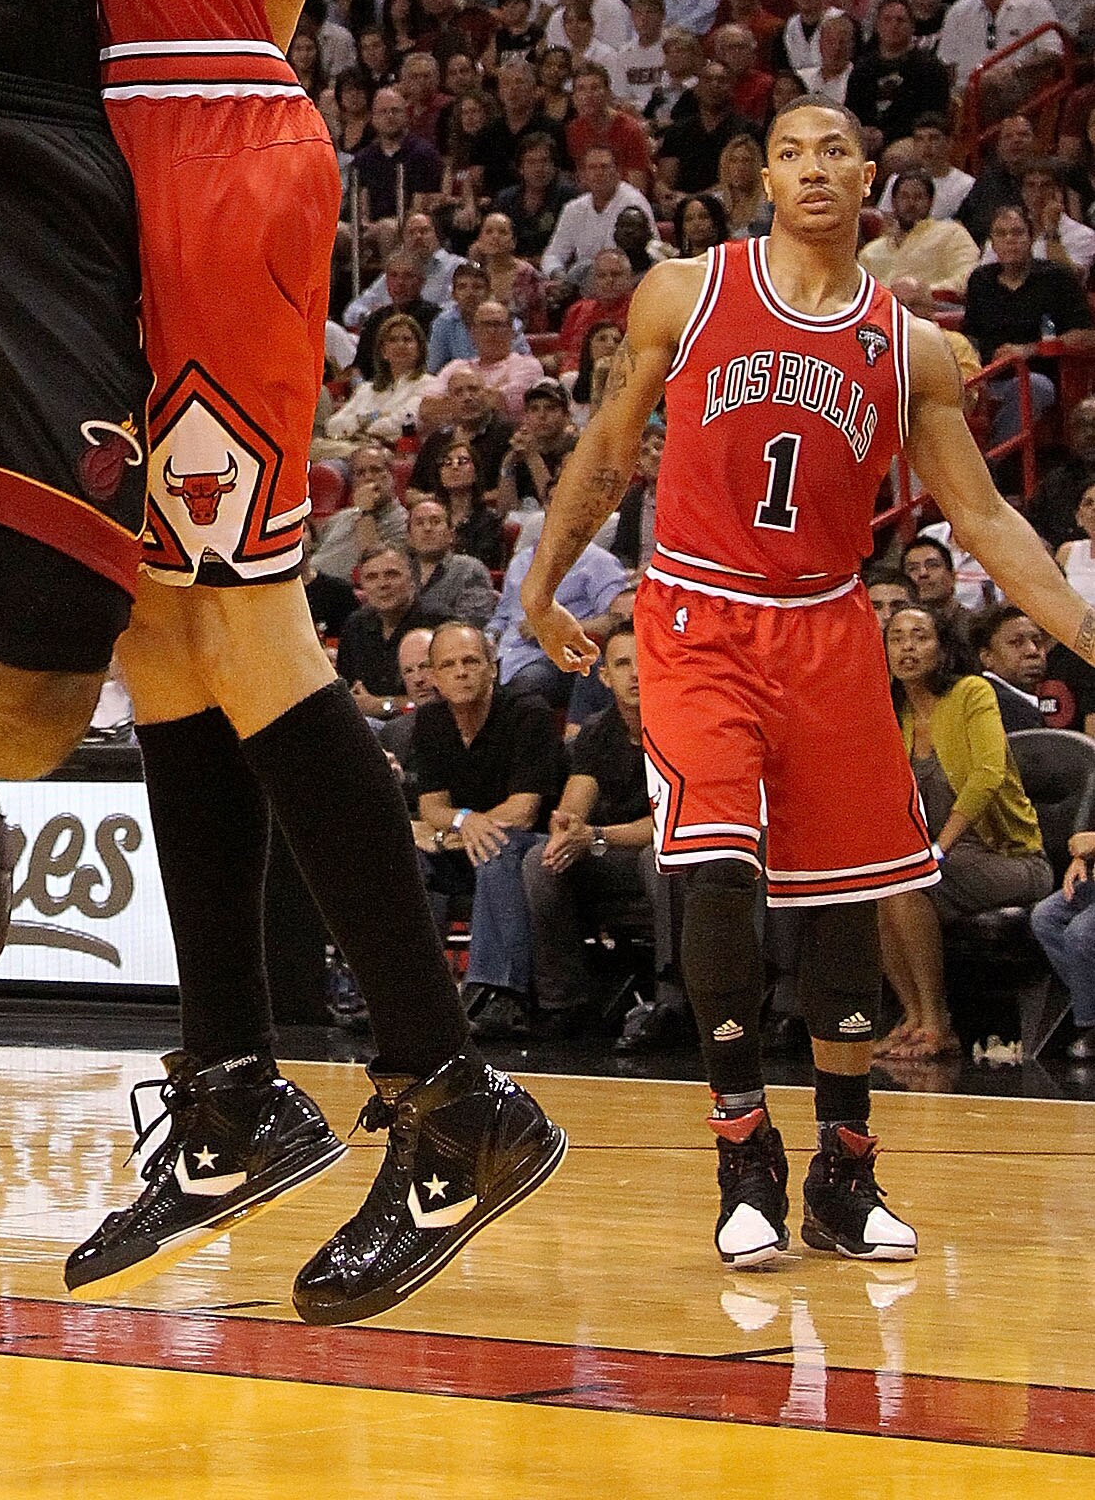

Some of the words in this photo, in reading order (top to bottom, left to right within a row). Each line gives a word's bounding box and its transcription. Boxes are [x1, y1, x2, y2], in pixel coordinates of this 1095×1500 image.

[701, 351, 774, 427] LOS
[772, 350, 879, 463] BULLS
[753, 431, 802, 533] 1
